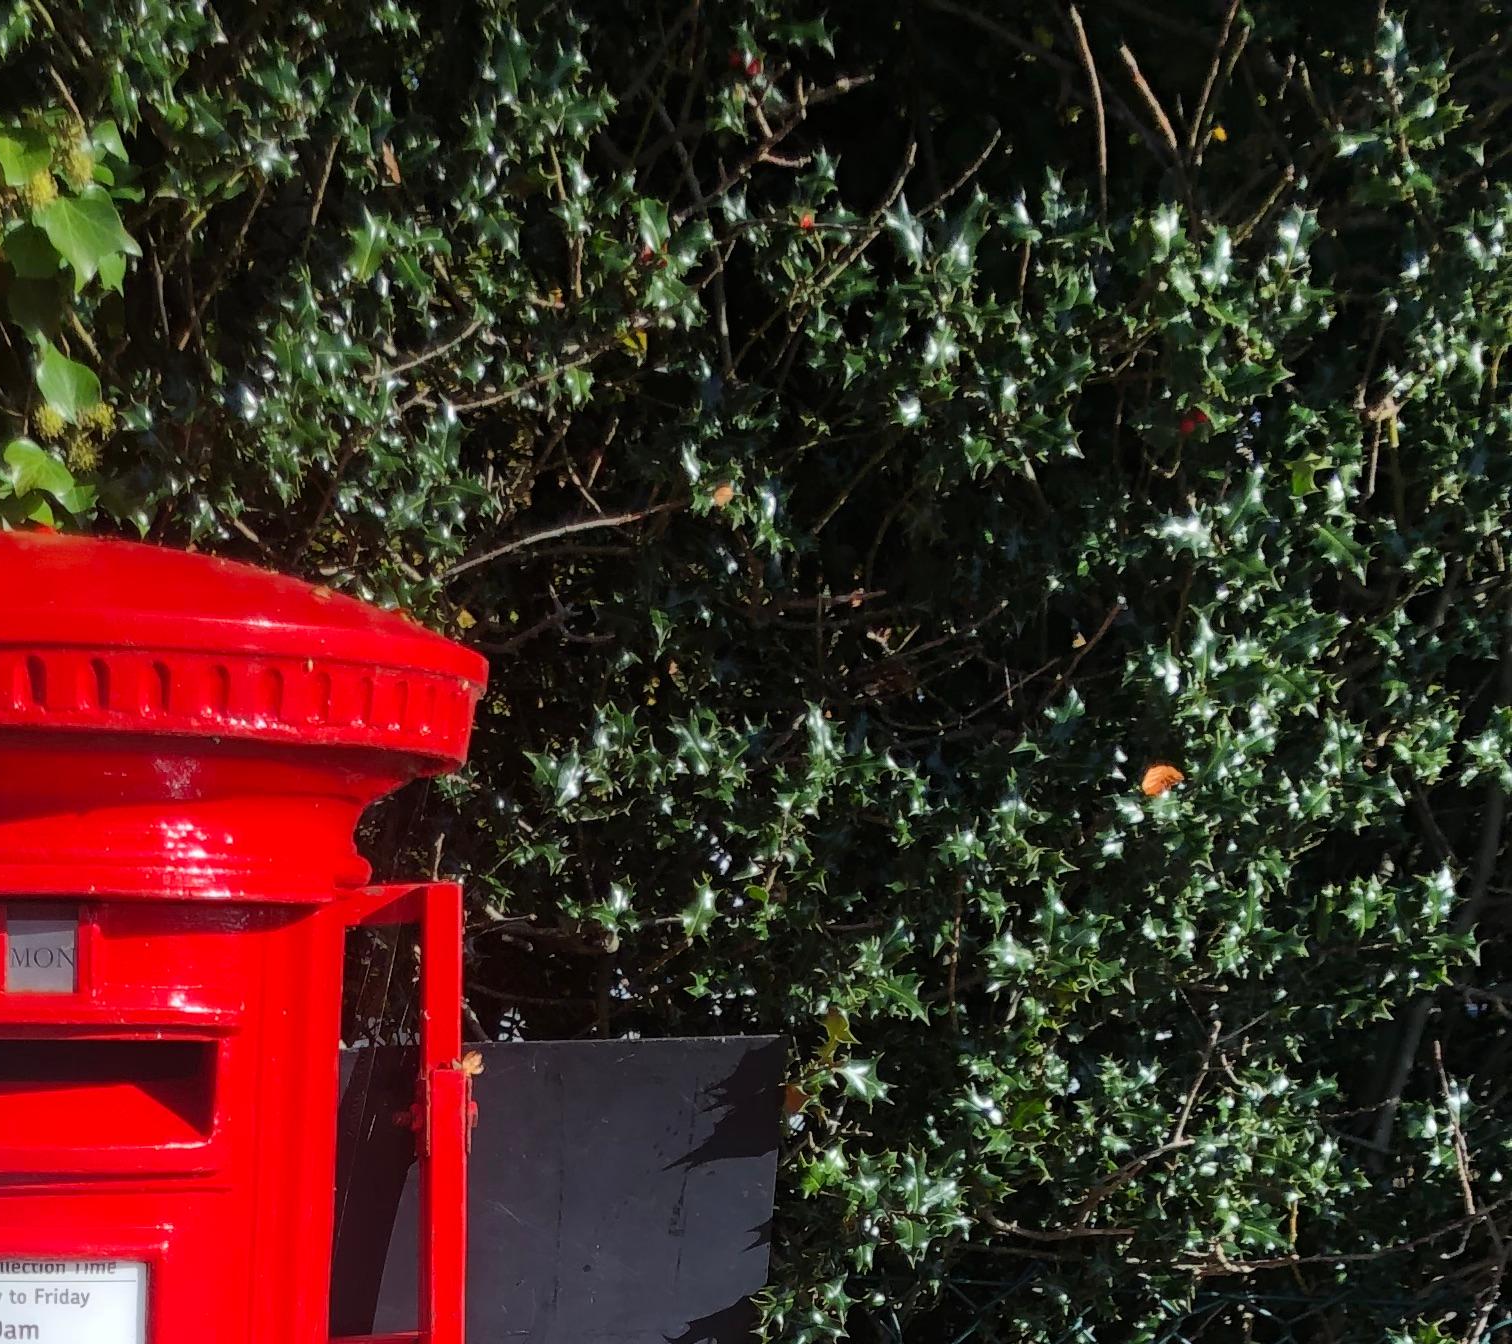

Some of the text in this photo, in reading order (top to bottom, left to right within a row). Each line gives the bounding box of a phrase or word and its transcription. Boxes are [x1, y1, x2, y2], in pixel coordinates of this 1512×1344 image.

[10, 947, 76, 968] MON
[9, 1288, 27, 1305] to
[34, 1287, 90, 1308] Friday
